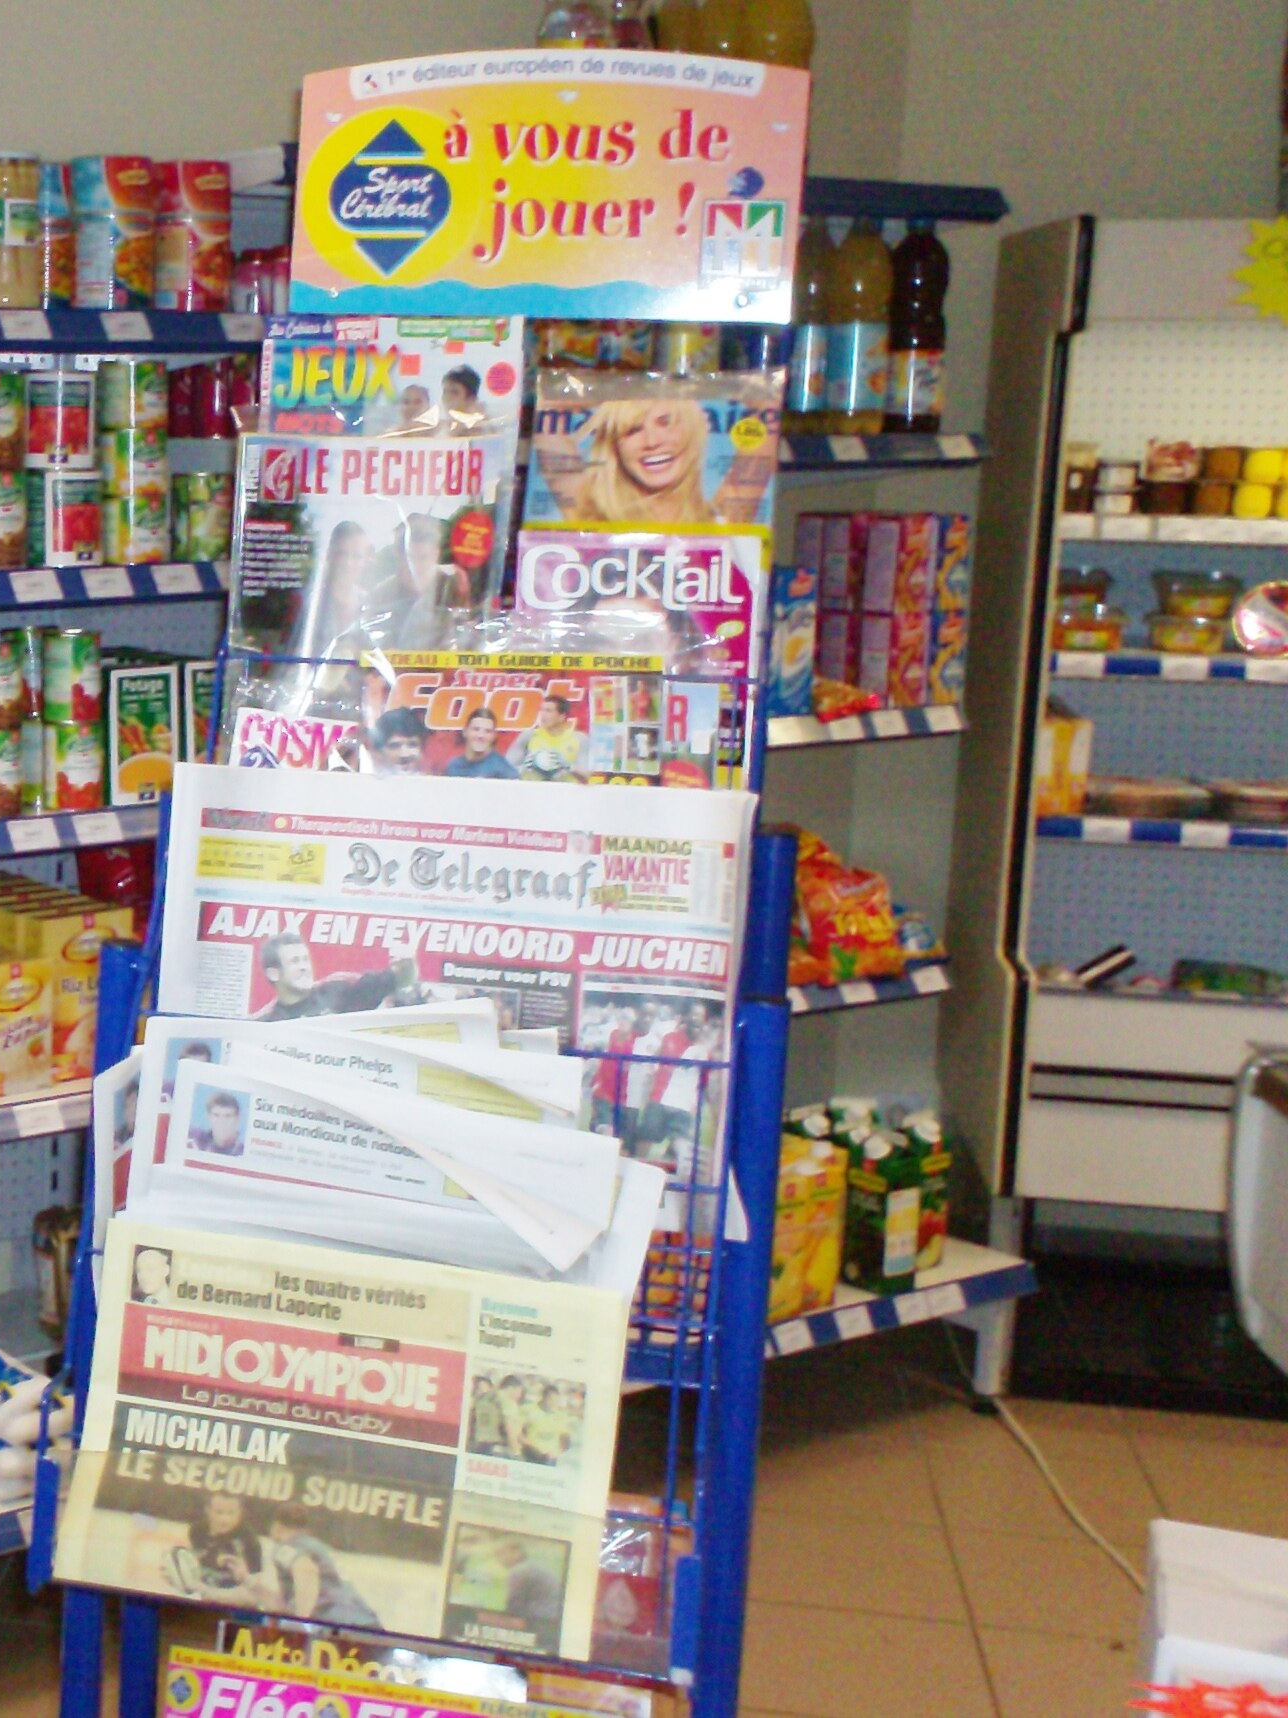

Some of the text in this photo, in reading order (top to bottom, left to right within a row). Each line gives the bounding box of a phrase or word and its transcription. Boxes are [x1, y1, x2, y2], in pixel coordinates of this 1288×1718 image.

[413, 61, 477, 83] éditeur
[483, 55, 574, 77] européen
[580, 56, 605, 74] de
[611, 59, 676, 79] revues
[682, 62, 707, 82] de
[710, 65, 754, 89] jeux
[442, 108, 731, 165] à vous de
[364, 165, 435, 201] Sport
[473, 177, 656, 263] jouer
[274, 344, 399, 409] JEUX
[299, 447, 330, 495] LE
[391, 653, 438, 666] DEAU
[498, 654, 552, 667] GUIDE
[561, 655, 583, 668] DE
[593, 655, 652, 669] POCHE
[453, 667, 541, 689] Super
[604, 836, 692, 855] MAANDAG
[342, 842, 400, 888] De
[407, 845, 597, 910] Telegraaf
[603, 855, 691, 885] VAKANTIE
[208, 906, 728, 977] AJAX EN FEYENOORD JUICHEN
[504, 971, 538, 985] voor
[539, 971, 572, 988] PSV
[314, 1052, 346, 1069] pour
[348, 1055, 393, 1074] Phelps
[254, 1098, 274, 1115] Six
[276, 1102, 341, 1126] médailles
[252, 1118, 278, 1132] aux
[280, 1122, 348, 1146] Mondiaux
[351, 1133, 368, 1148] de
[177, 1281, 343, 1321] de Bernard Laporte
[274, 1271, 427, 1310] les quatre vérités
[143, 1325, 441, 1413] MIDI OLYMPIQUE
[182, 1384, 393, 1434] Le journal du rugby
[124, 1407, 291, 1466] MICHALAK
[116, 1446, 444, 1528] LE SECOND SOUFFLE
